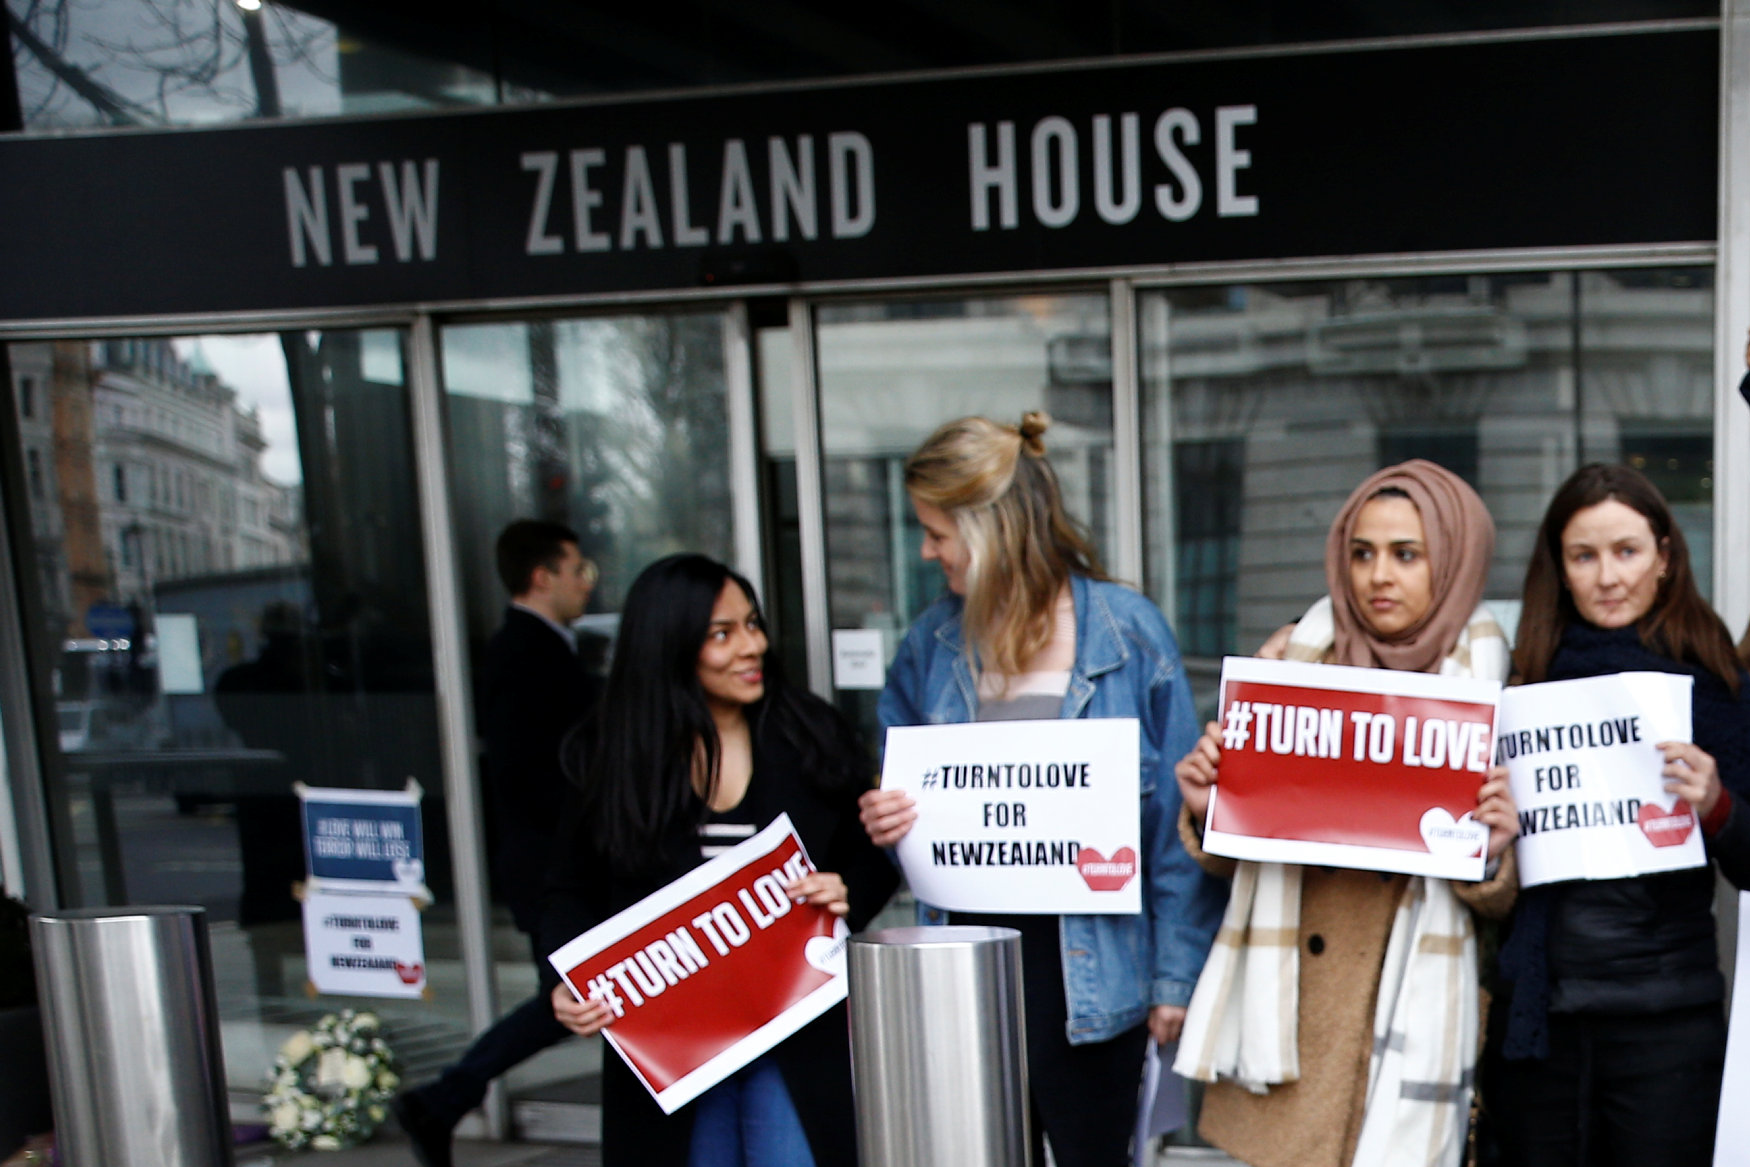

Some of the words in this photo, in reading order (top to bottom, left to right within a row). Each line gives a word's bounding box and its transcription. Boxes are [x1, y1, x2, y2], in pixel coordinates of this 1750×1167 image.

[284, 159, 439, 267] NEW
[520, 130, 876, 255] ZEALAND
[968, 104, 1259, 231] HOUSE
[1223, 701, 1343, 759] #TURN
[1351, 711, 1396, 763] TO
[1403, 716, 1490, 772] LOVE
[922, 763, 1090, 789] #TURNTOLOVE
[1535, 764, 1581, 793] FOR
[984, 803, 1026, 827] FOR
[587, 926, 709, 1018] #TURN
[692, 901, 751, 957] TO
